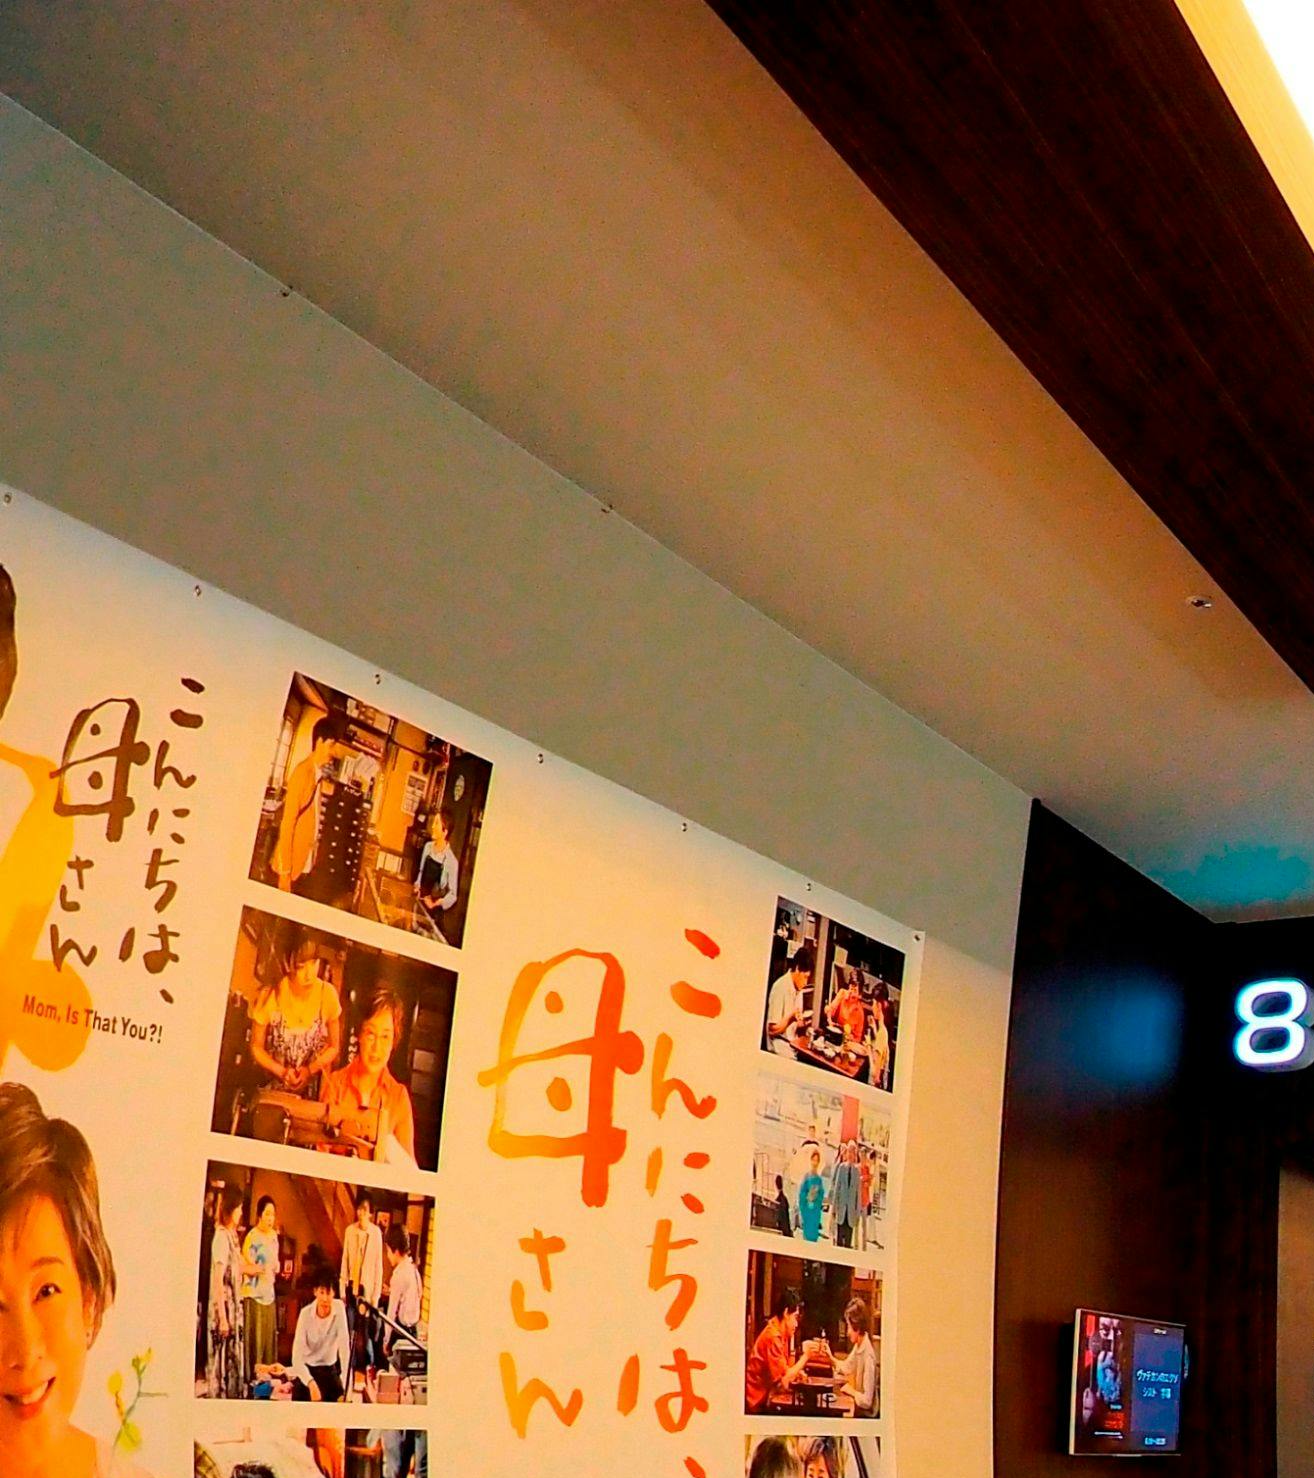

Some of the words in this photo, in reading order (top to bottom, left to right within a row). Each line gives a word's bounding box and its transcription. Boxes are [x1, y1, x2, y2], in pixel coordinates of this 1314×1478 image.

[49, 697, 151, 972] 母さん
[118, 677, 205, 1003] こんにちは、
[22, 994, 61, 1024] Mom,
[66, 1004, 79, 1025] Is
[83, 1008, 117, 1035] That
[121, 1016, 163, 1044] You?!
[1234, 977, 1310, 1066] 8
[477, 947, 645, 1439] 母さん
